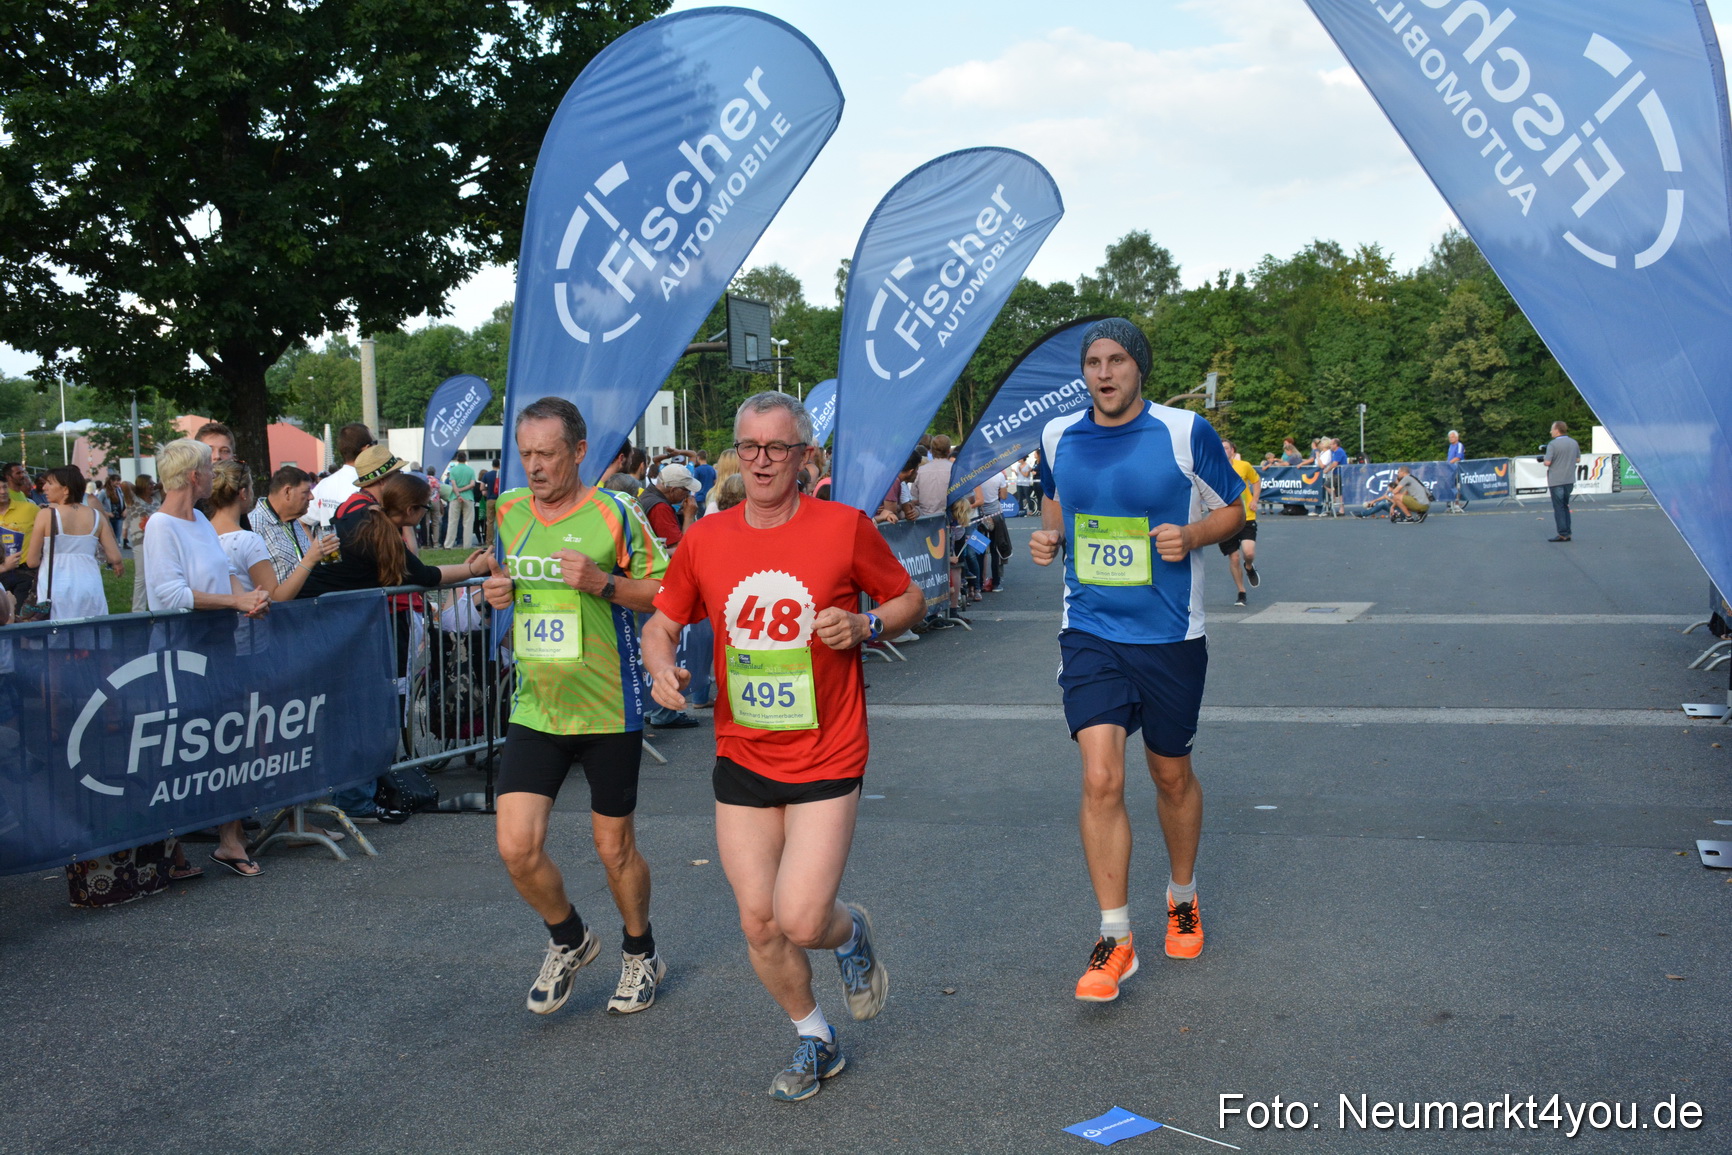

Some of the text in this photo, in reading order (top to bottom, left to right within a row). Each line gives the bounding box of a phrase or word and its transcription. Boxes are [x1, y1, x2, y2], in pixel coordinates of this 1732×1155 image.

[597, 66, 776, 303] Fischer
[658, 112, 792, 301] AUTOMOBILE
[893, 183, 1014, 352] Fischer
[937, 213, 1028, 349] AUTOMOBILE
[440, 386, 477, 438] Fischer
[452, 395, 482, 437] AUTOMOBILE
[812, 390, 837, 431] Fische
[980, 375, 1088, 445] Frischman
[1057, 393, 1087, 414] Druck
[1460, 472, 1497, 484] Frischmann
[1088, 543, 1134, 567] 789
[523, 618, 565, 643] 148
[741, 681, 796, 708] 495
[127, 691, 326, 775] Fischer
[148, 745, 314, 807] AUTOMOBILE
